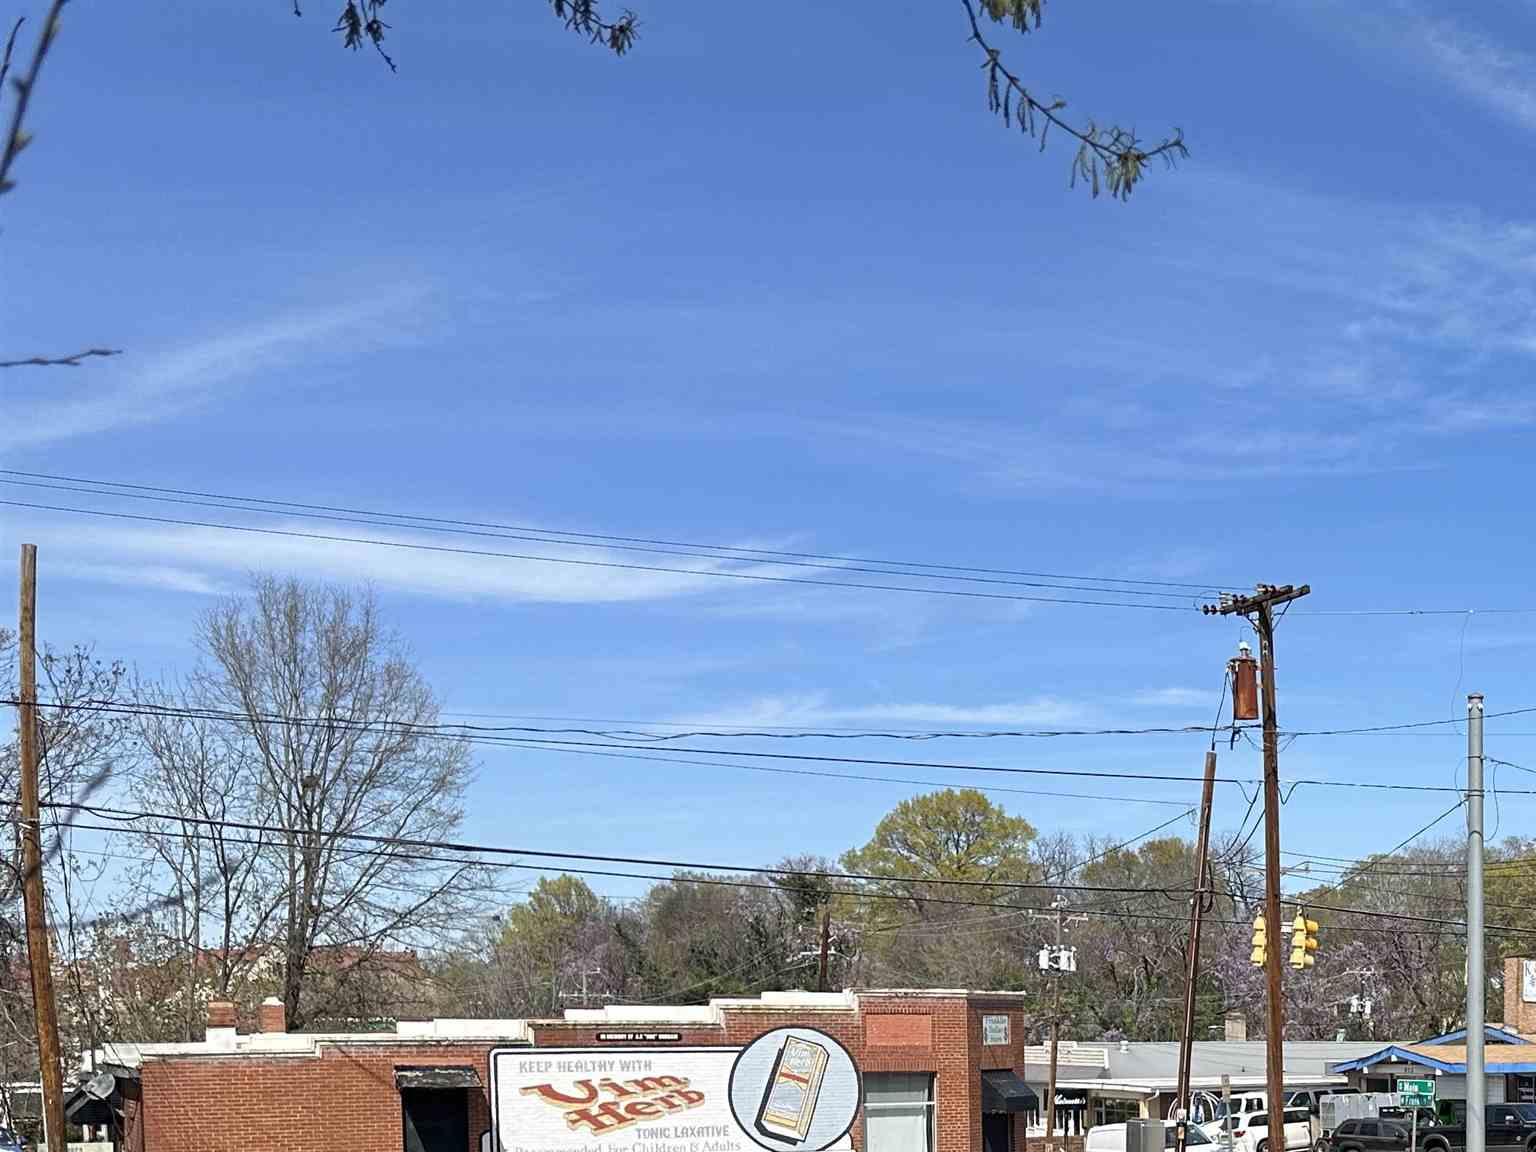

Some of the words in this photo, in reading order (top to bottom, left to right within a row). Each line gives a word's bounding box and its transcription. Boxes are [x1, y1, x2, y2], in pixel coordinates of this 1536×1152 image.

[519, 1060, 552, 1073] KEEP
[557, 1060, 616, 1073] HEALTHY
[619, 1060, 652, 1072] WITH
[562, 1089, 706, 1137] Herb
[636, 1127, 670, 1139] TONIC
[674, 1125, 730, 1138] LAXATIVE
[703, 1140, 742, 1152] Adults
